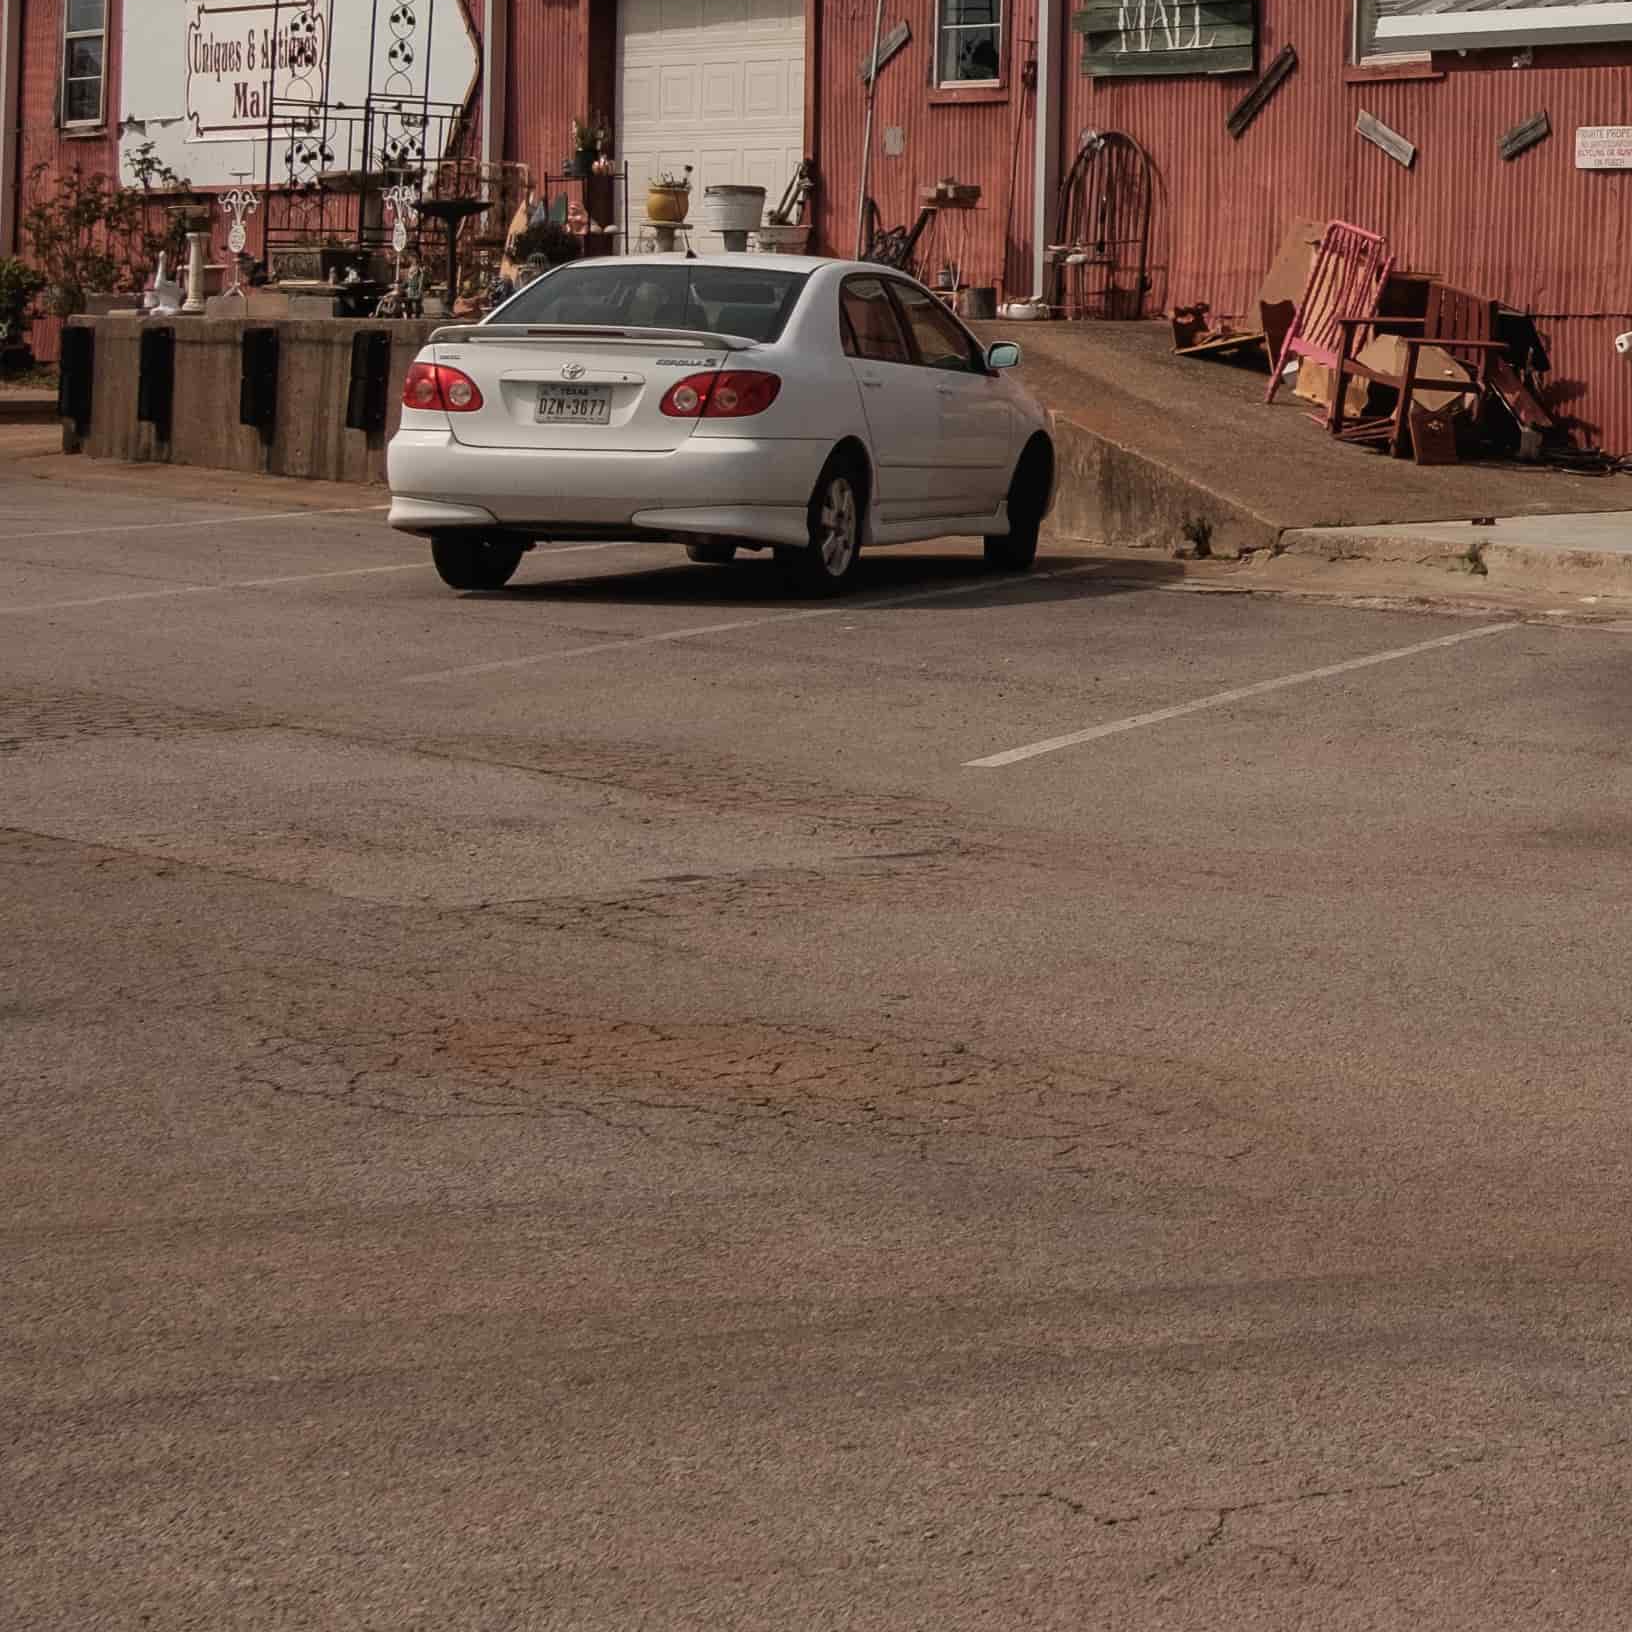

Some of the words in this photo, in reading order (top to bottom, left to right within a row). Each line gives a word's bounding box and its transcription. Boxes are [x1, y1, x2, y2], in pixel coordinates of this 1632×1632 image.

[193, 32, 242, 82] Uniques
[247, 29, 256, 71] &
[261, 27, 317, 78] Atiques
[232, 80, 273, 119] Mal
